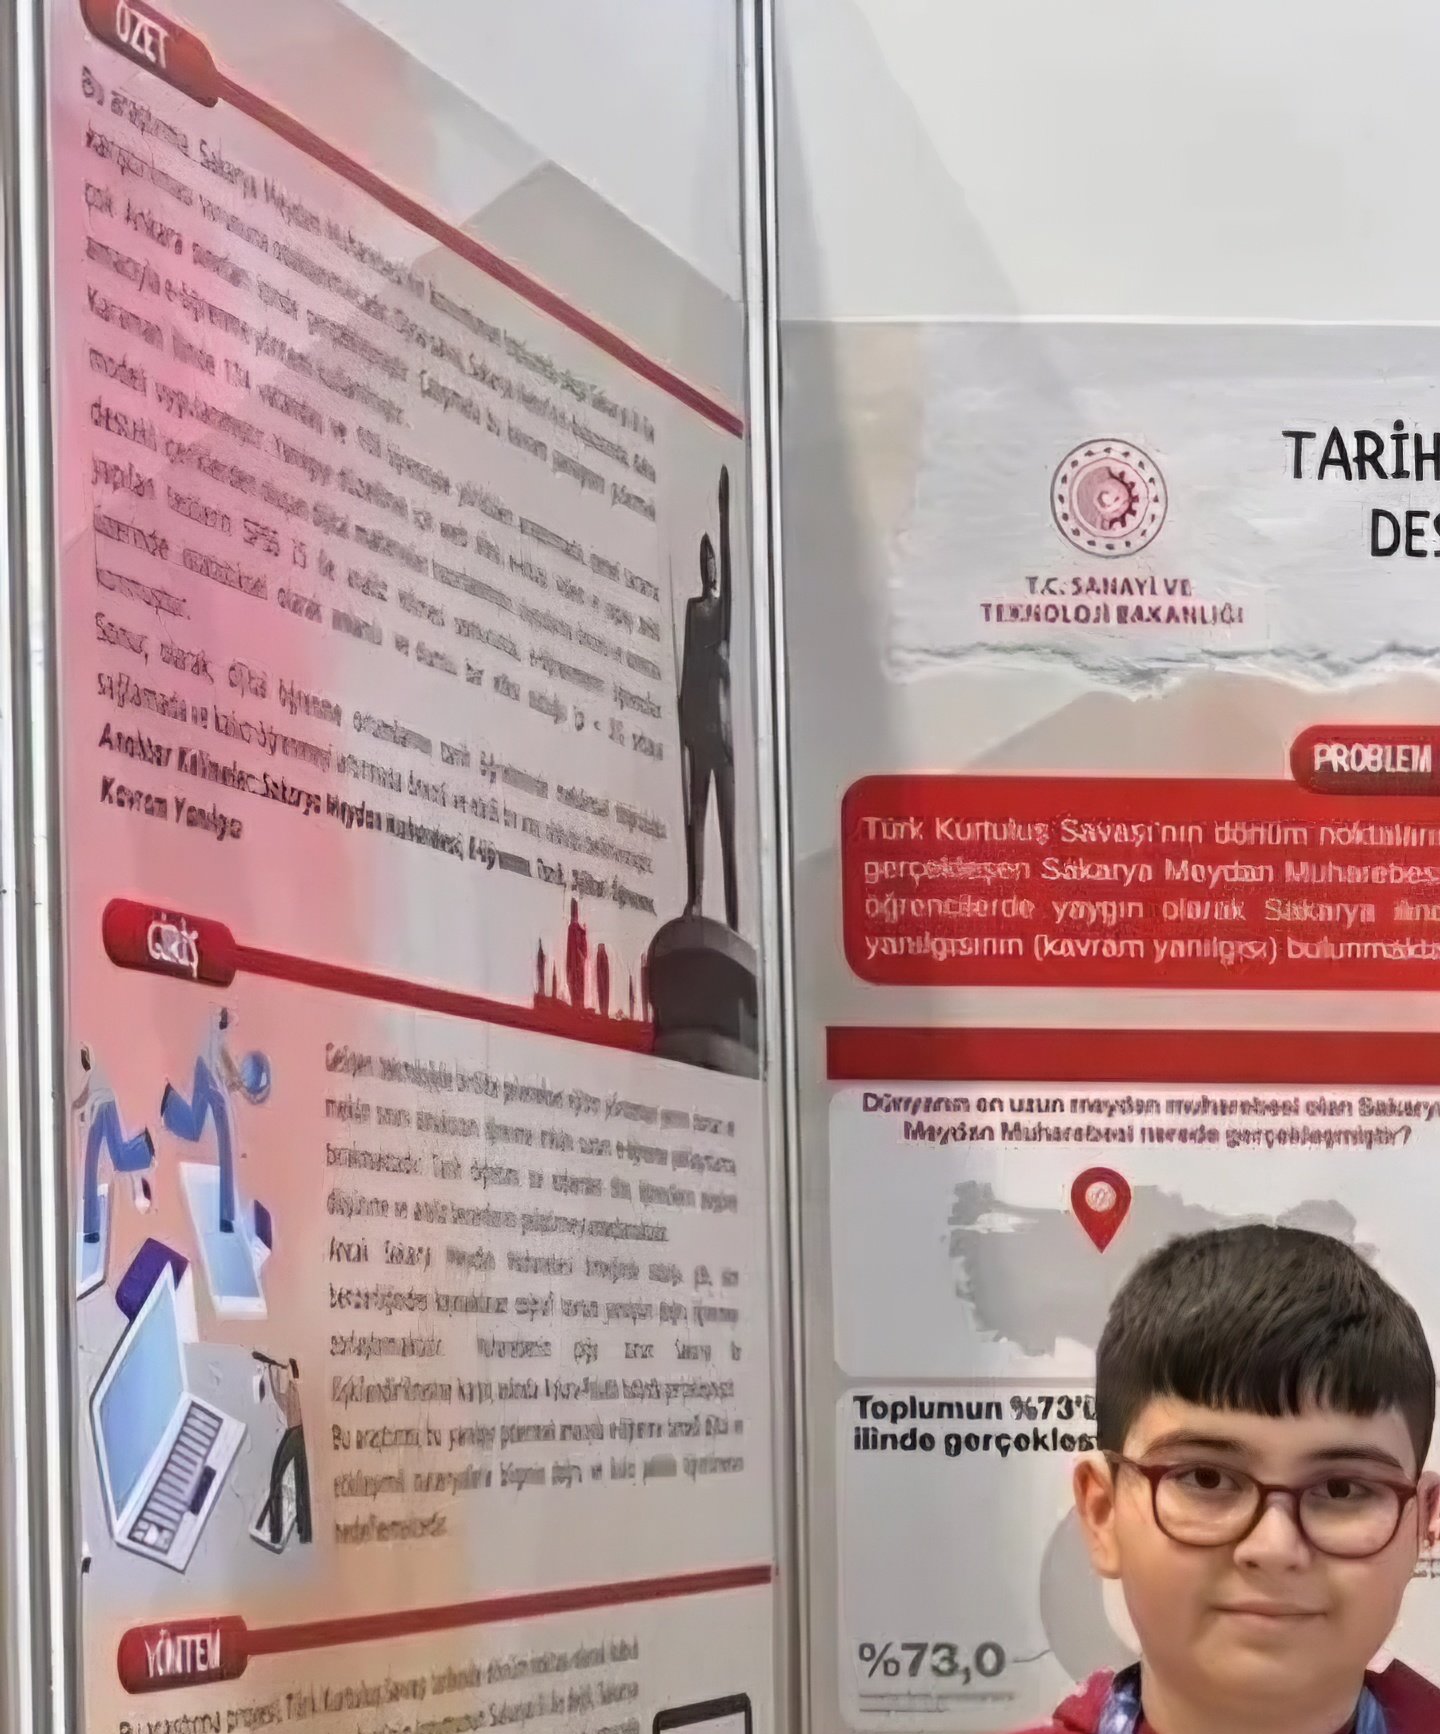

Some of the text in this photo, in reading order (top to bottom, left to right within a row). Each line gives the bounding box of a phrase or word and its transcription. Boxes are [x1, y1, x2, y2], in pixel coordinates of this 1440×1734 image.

[1313, 742, 1433, 774] PROBLEM
[863, 814, 925, 844] Türk
[852, 1395, 1004, 1425] Toplumun
[853, 1427, 936, 1452] ilinde
[858, 1641, 1006, 1685] %73,0
